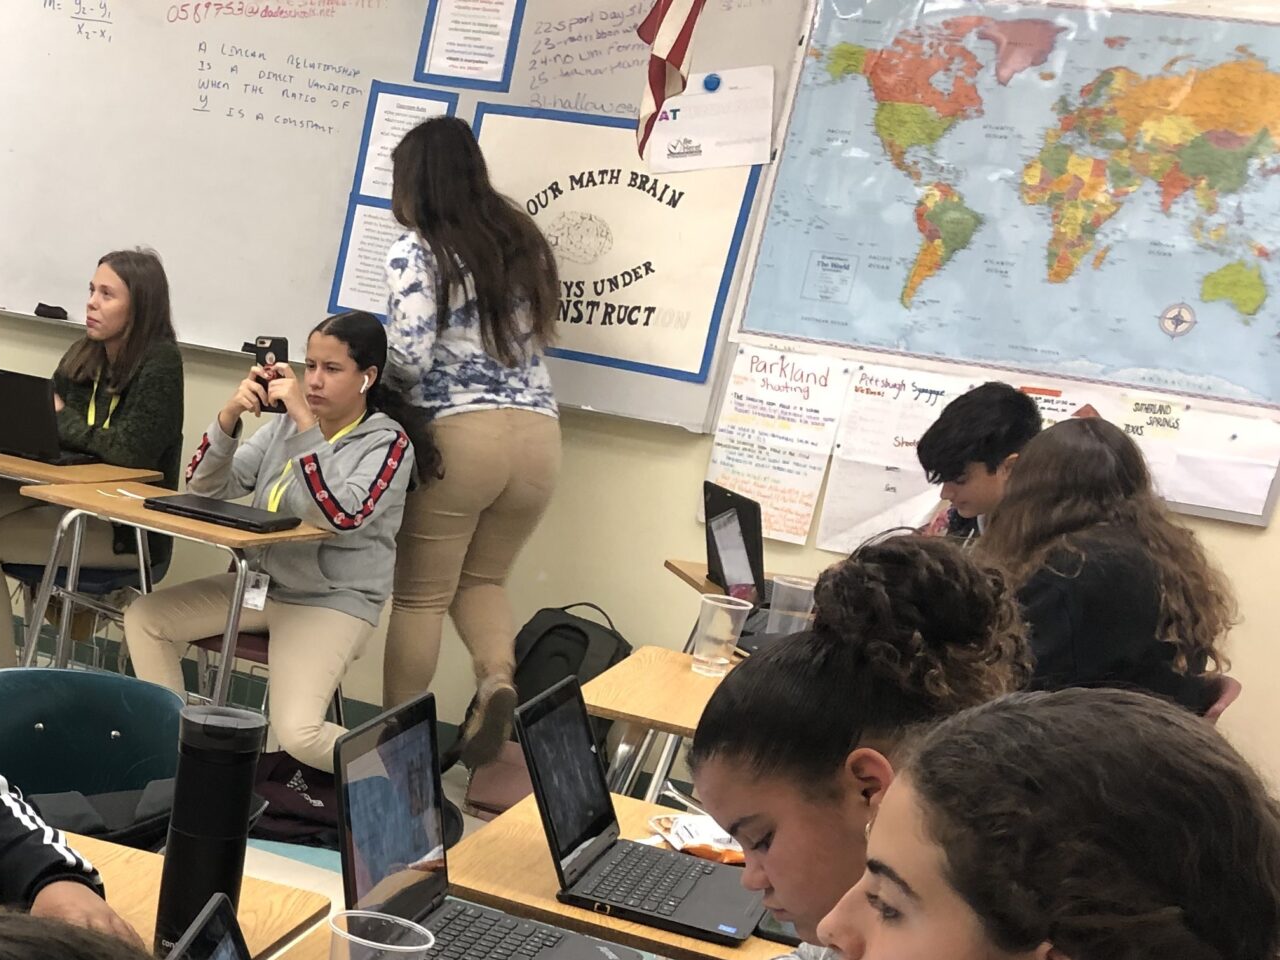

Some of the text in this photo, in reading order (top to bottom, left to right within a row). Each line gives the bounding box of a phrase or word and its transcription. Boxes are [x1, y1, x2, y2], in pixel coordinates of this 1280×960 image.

[198, 41, 207, 52] A
[286, 54, 360, 78] RELATIONSHIP
[230, 65, 238, 74] A
[198, 78, 350, 109] WHEN THE RATIO OF
[226, 107, 245, 118] IS
[256, 112, 264, 121] A
[569, 169, 622, 191] MATH
[627, 171, 685, 209] BRAIN
[593, 261, 656, 297] UNDER
[750, 355, 830, 388] Parkland
